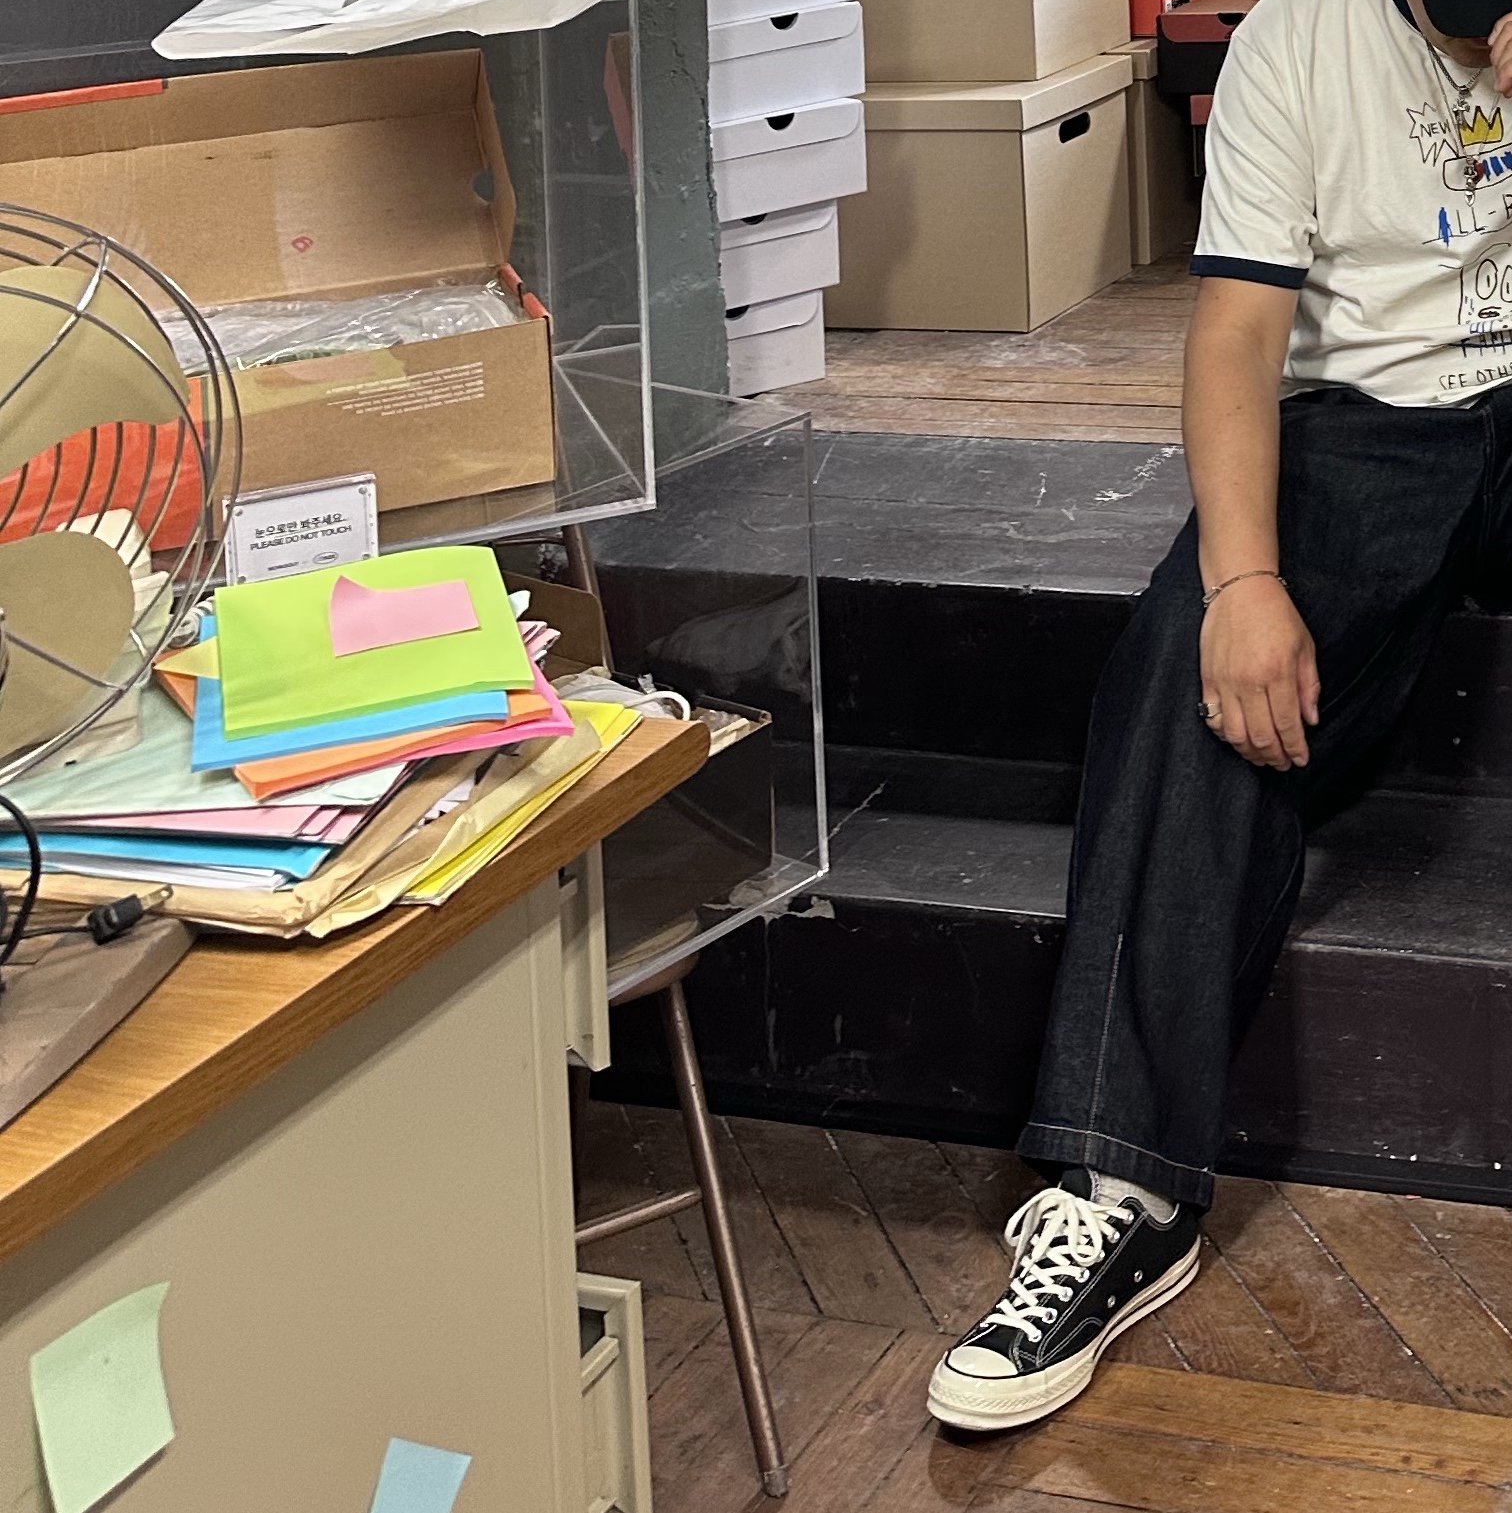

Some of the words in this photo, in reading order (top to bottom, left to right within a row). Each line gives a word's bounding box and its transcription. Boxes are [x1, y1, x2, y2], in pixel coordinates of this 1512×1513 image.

[1419, 118, 1451, 138] NEW
[250, 537, 286, 551] PLEASE
[286, 535, 300, 545] DO
[300, 531, 319, 542] NOT
[320, 524, 352, 538] TOUCH
